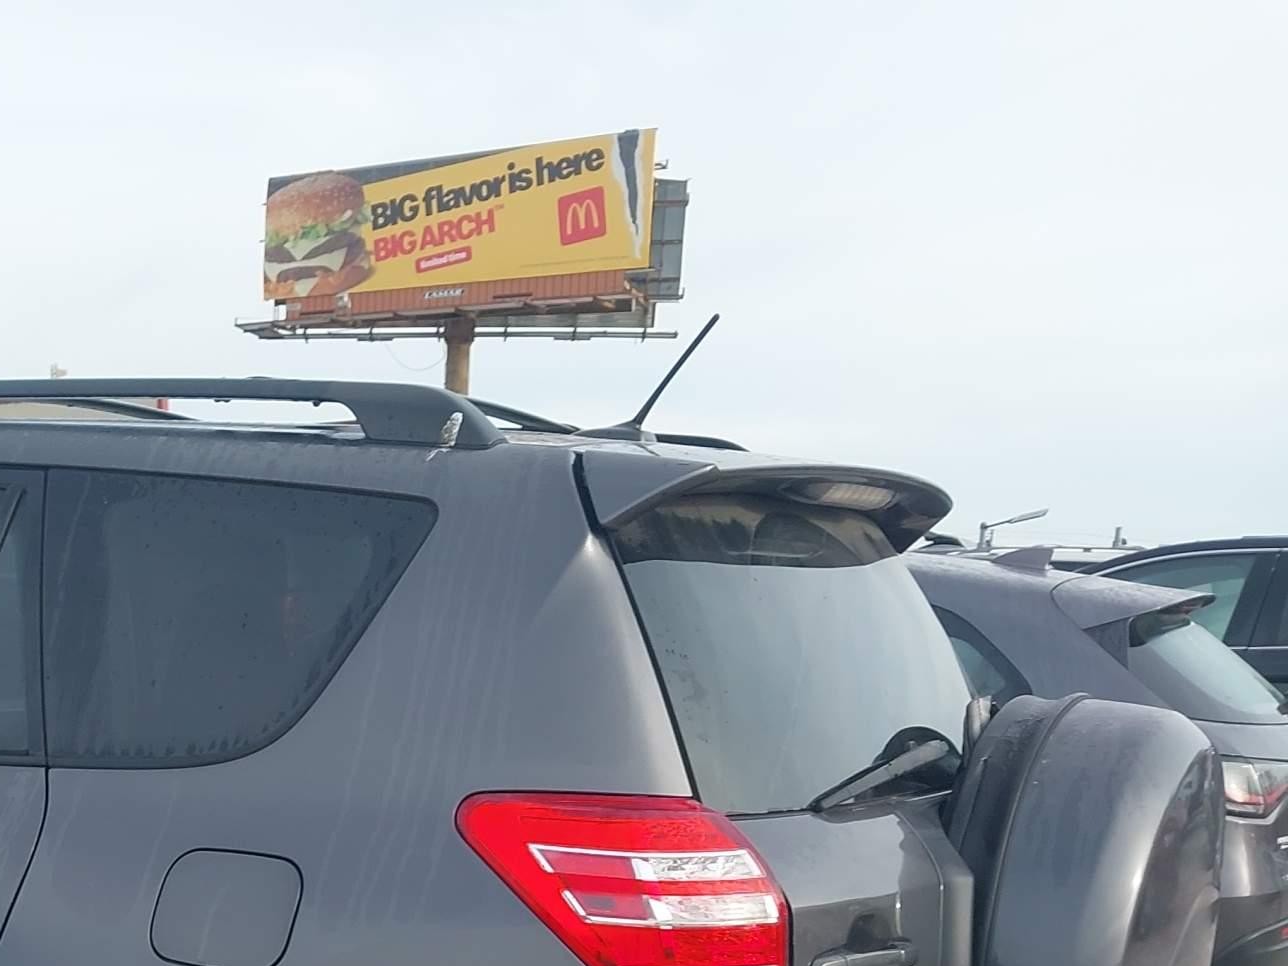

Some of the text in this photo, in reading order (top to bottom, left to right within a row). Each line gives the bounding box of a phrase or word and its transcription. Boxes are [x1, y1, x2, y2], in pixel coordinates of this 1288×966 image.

[371, 148, 605, 231] BIG flavor is here
[373, 230, 418, 262] BIG
